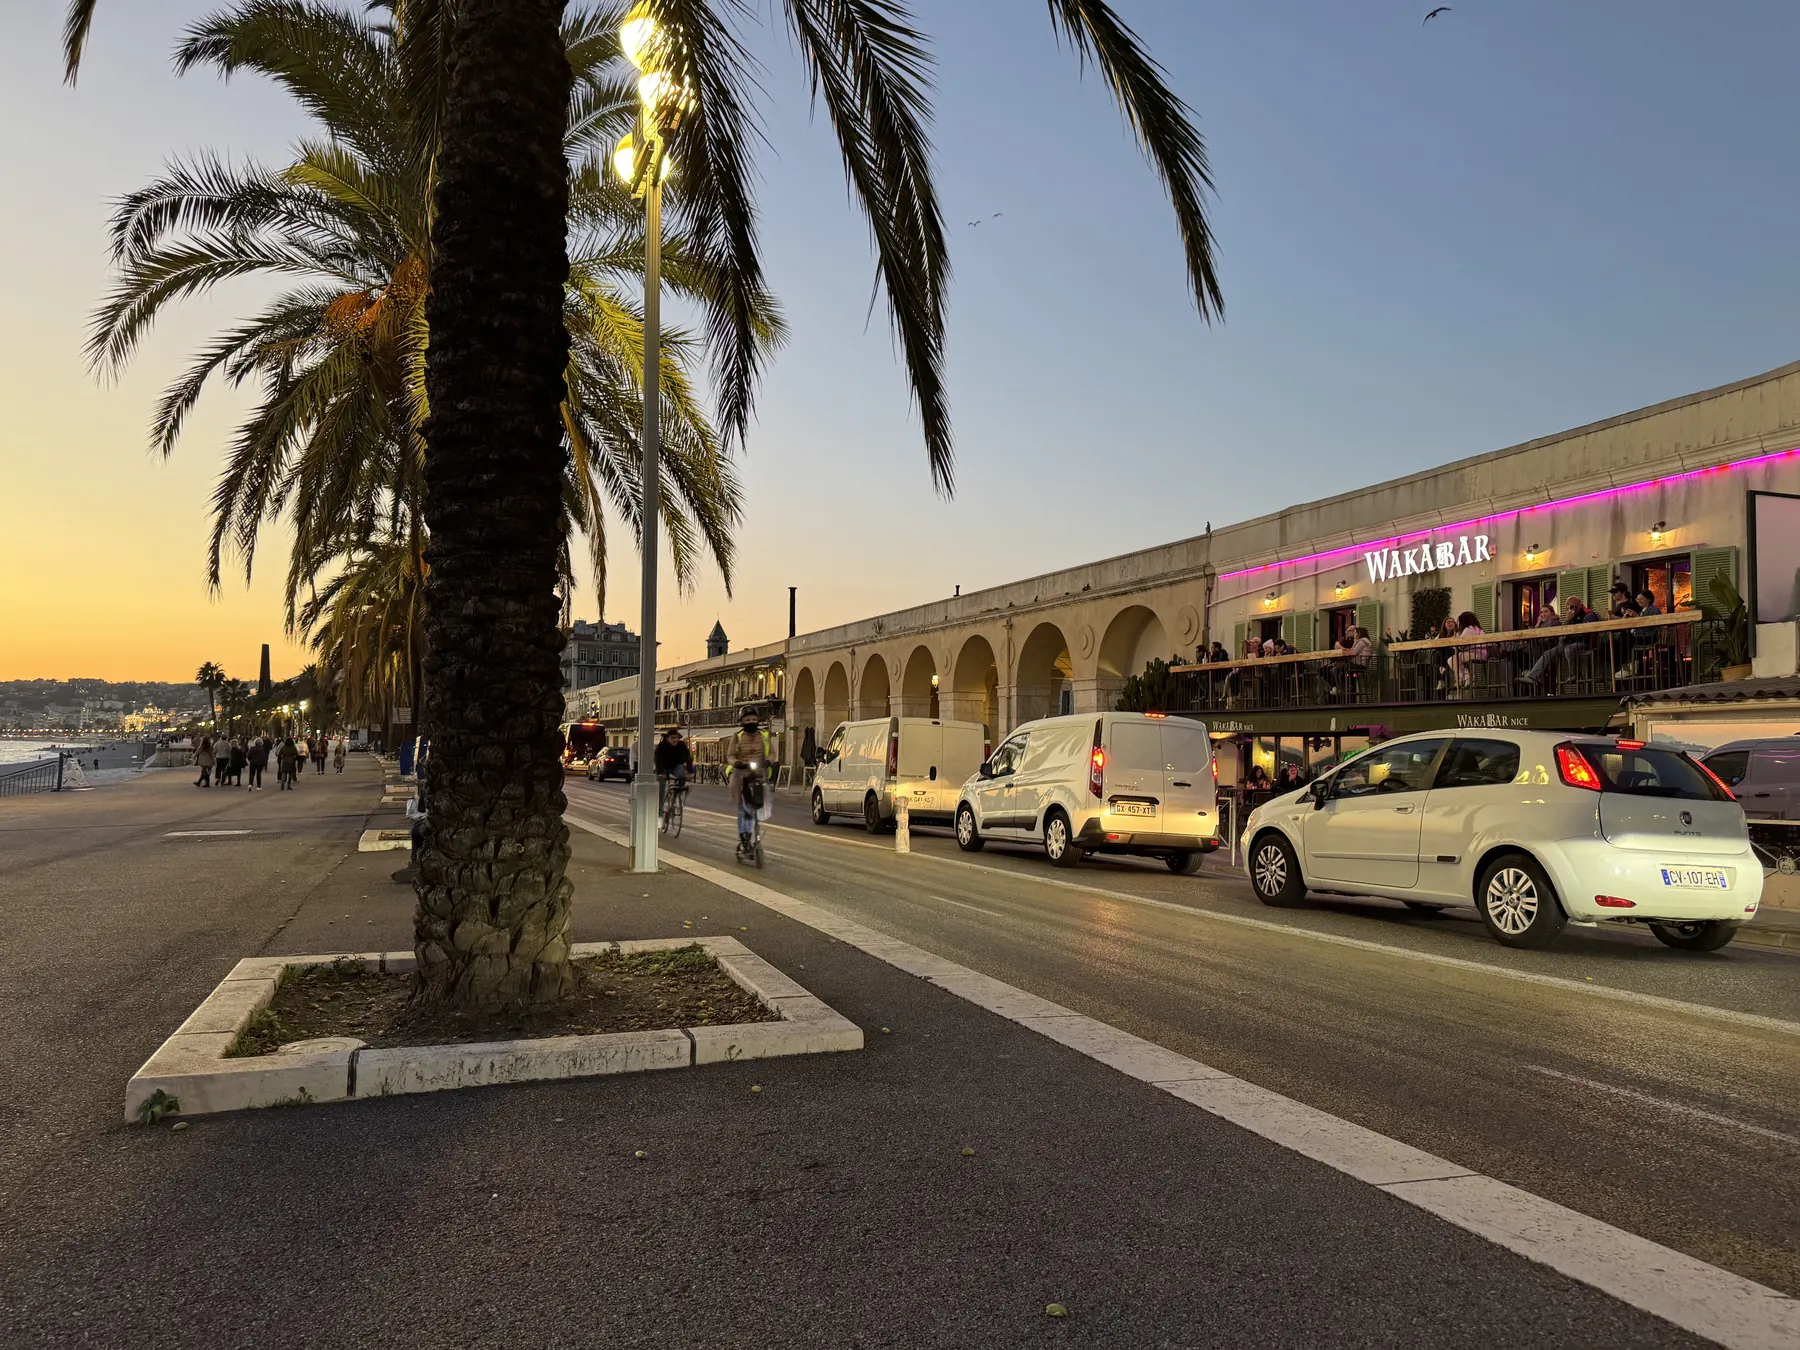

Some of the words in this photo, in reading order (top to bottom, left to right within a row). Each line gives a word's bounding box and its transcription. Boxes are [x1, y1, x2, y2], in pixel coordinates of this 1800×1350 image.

[1364, 535, 1492, 584] WAKABAR
[1457, 713, 1508, 728] WAKABAR
[1510, 717, 1529, 726] NICE
[1669, 870, 1720, 886] CV-107-EH
